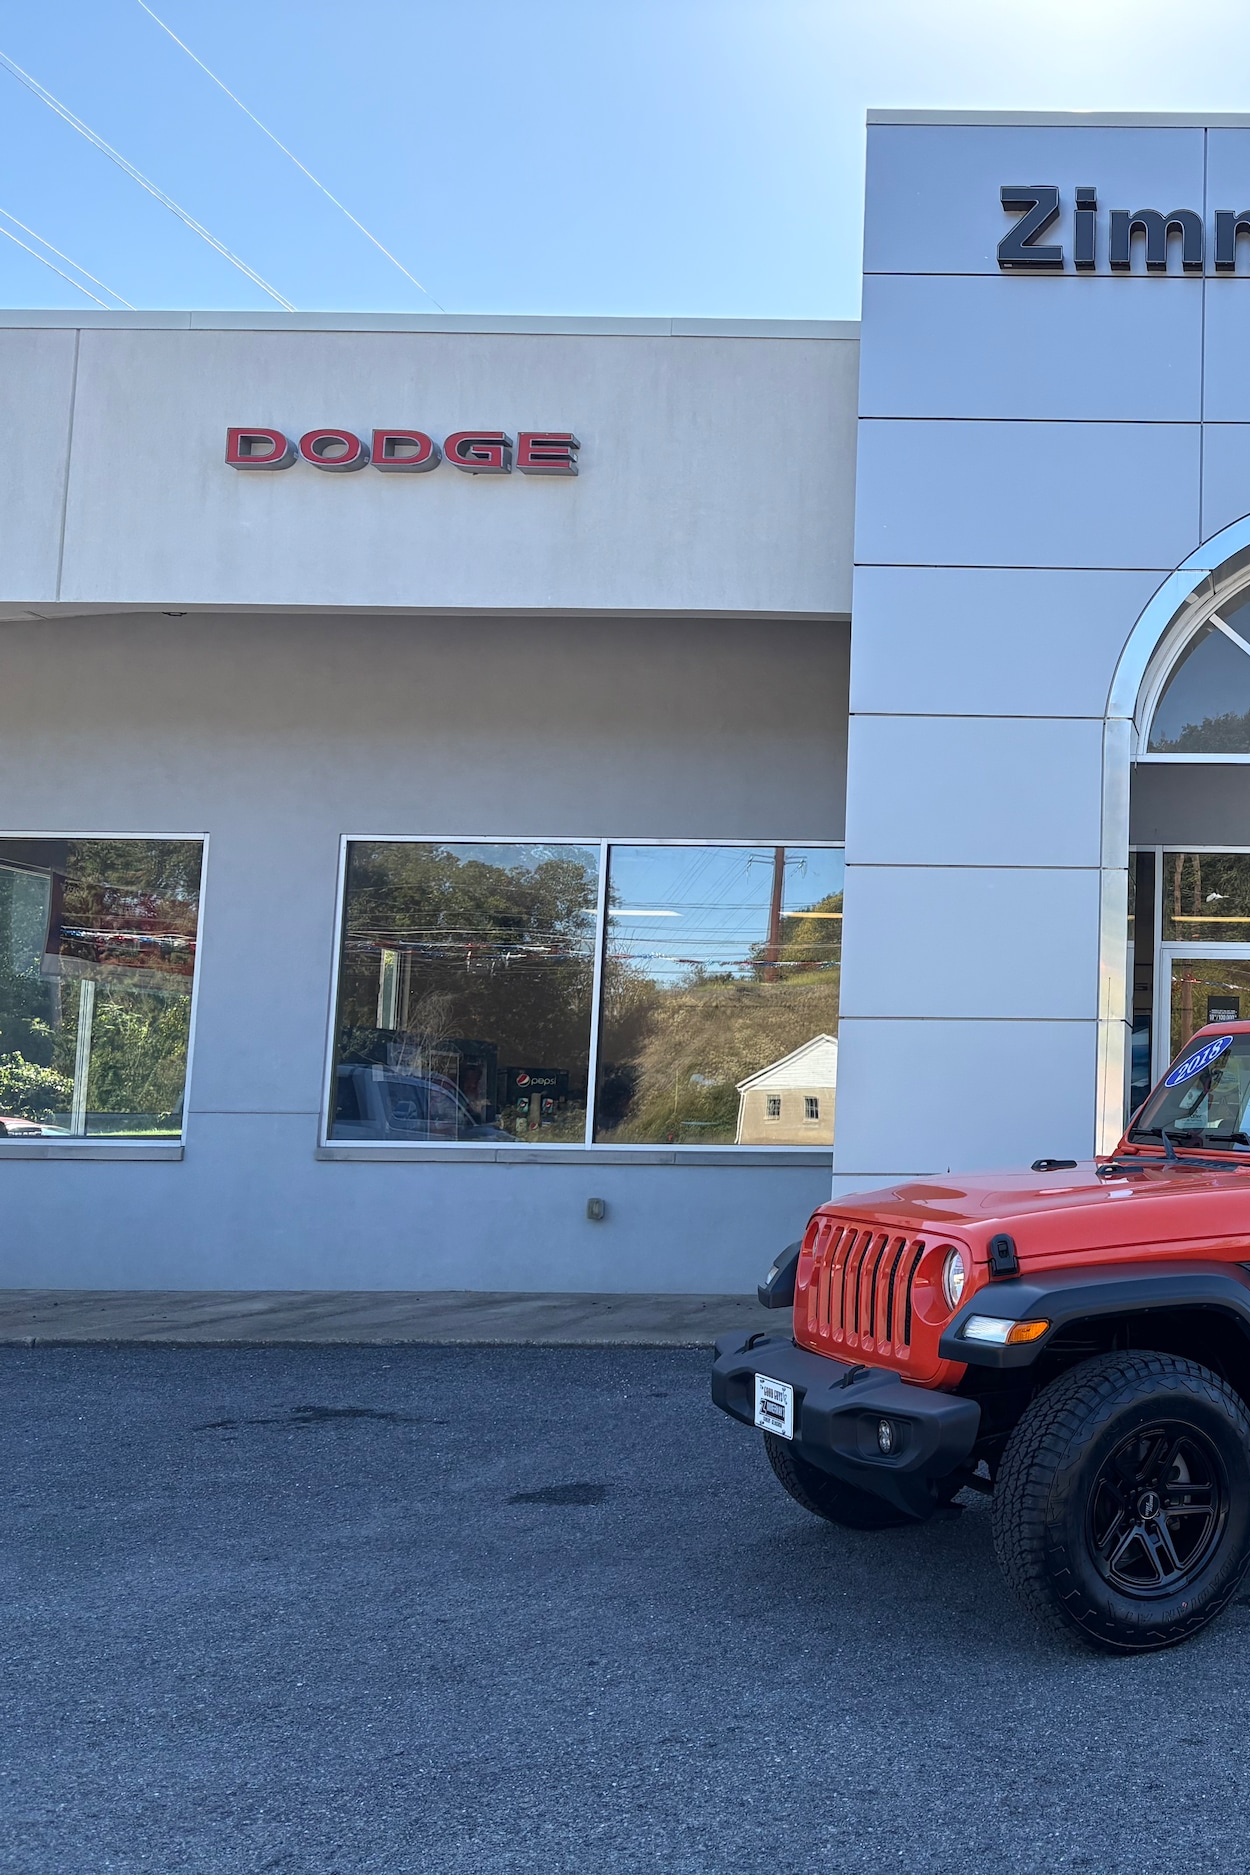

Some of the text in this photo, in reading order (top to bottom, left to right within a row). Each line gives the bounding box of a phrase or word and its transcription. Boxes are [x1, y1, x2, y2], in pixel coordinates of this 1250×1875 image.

[225, 427, 581, 476] DODGE
[531, 1076, 557, 1086] pepsi
[1174, 1039, 1223, 1083] 2018
